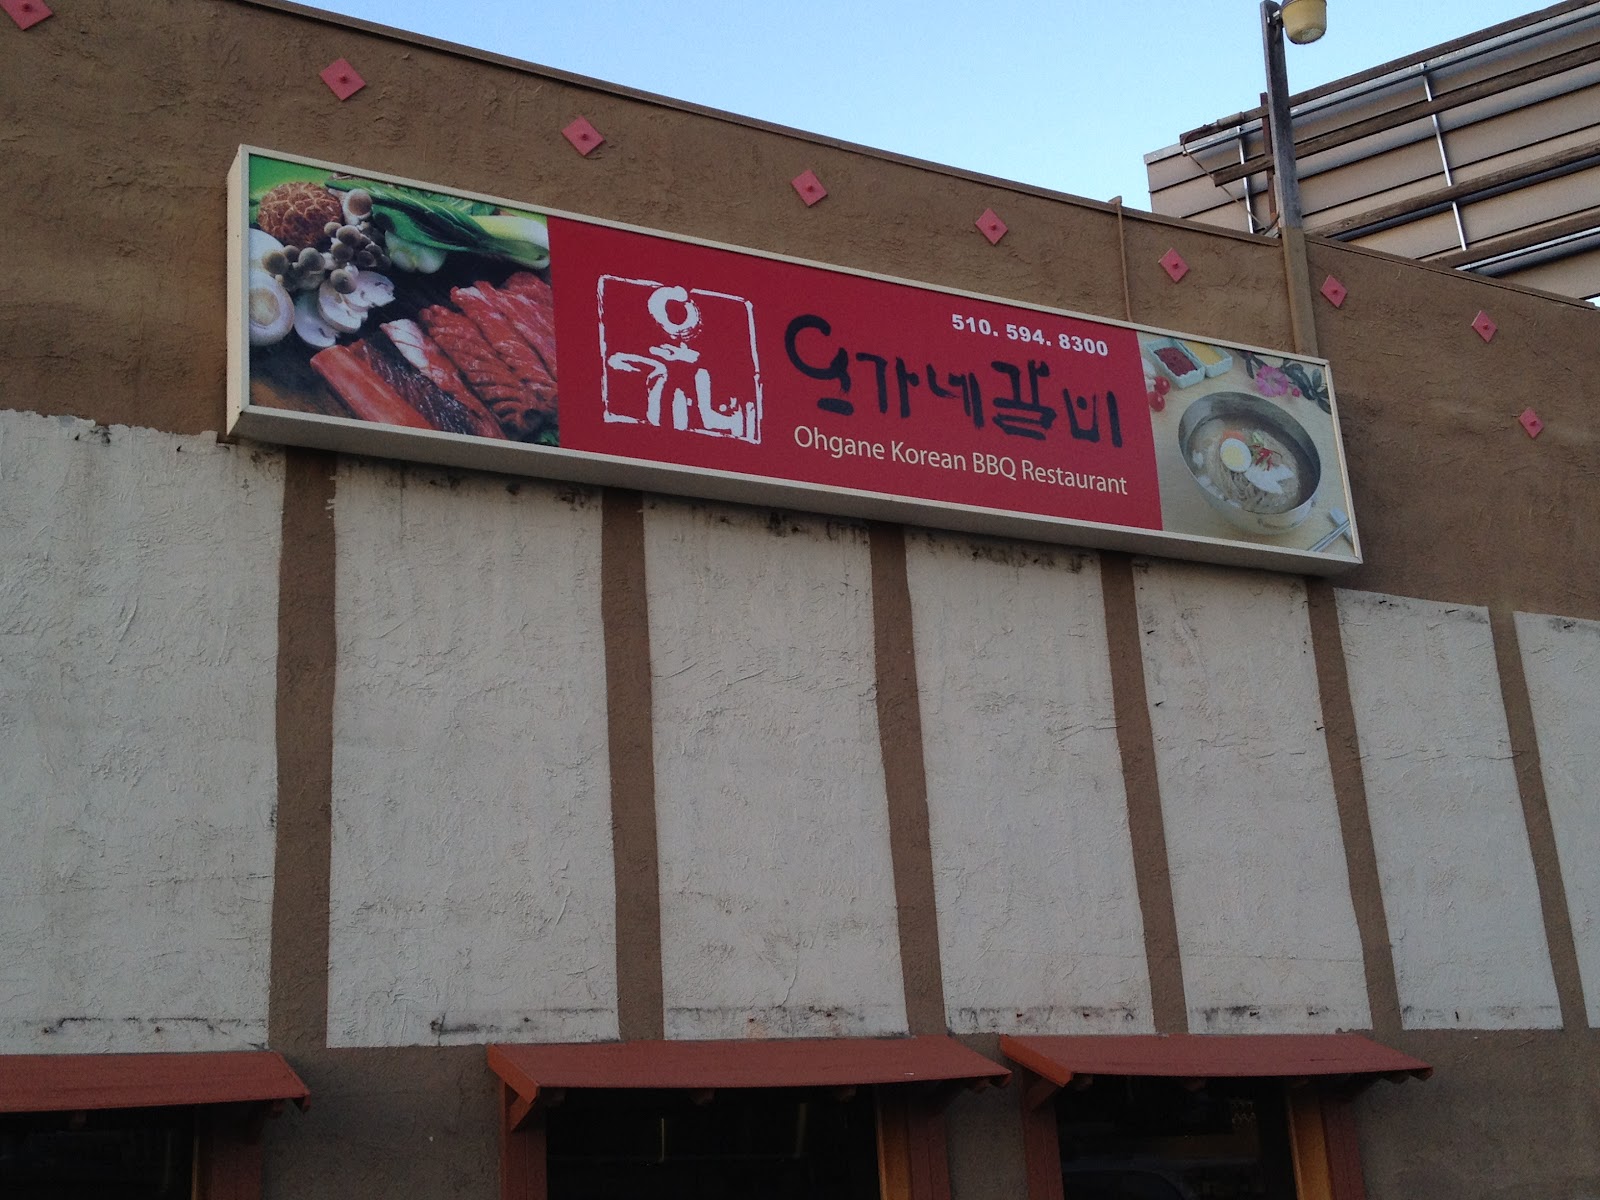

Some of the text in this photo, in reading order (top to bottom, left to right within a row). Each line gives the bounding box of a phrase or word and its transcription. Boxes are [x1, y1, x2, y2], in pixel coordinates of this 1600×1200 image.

[951, 313, 1109, 357] 510. 594. 8300
[784, 314, 1123, 448] 오가네갈비
[793, 425, 1128, 495] Ohgane Korean BBQ Restaurant
